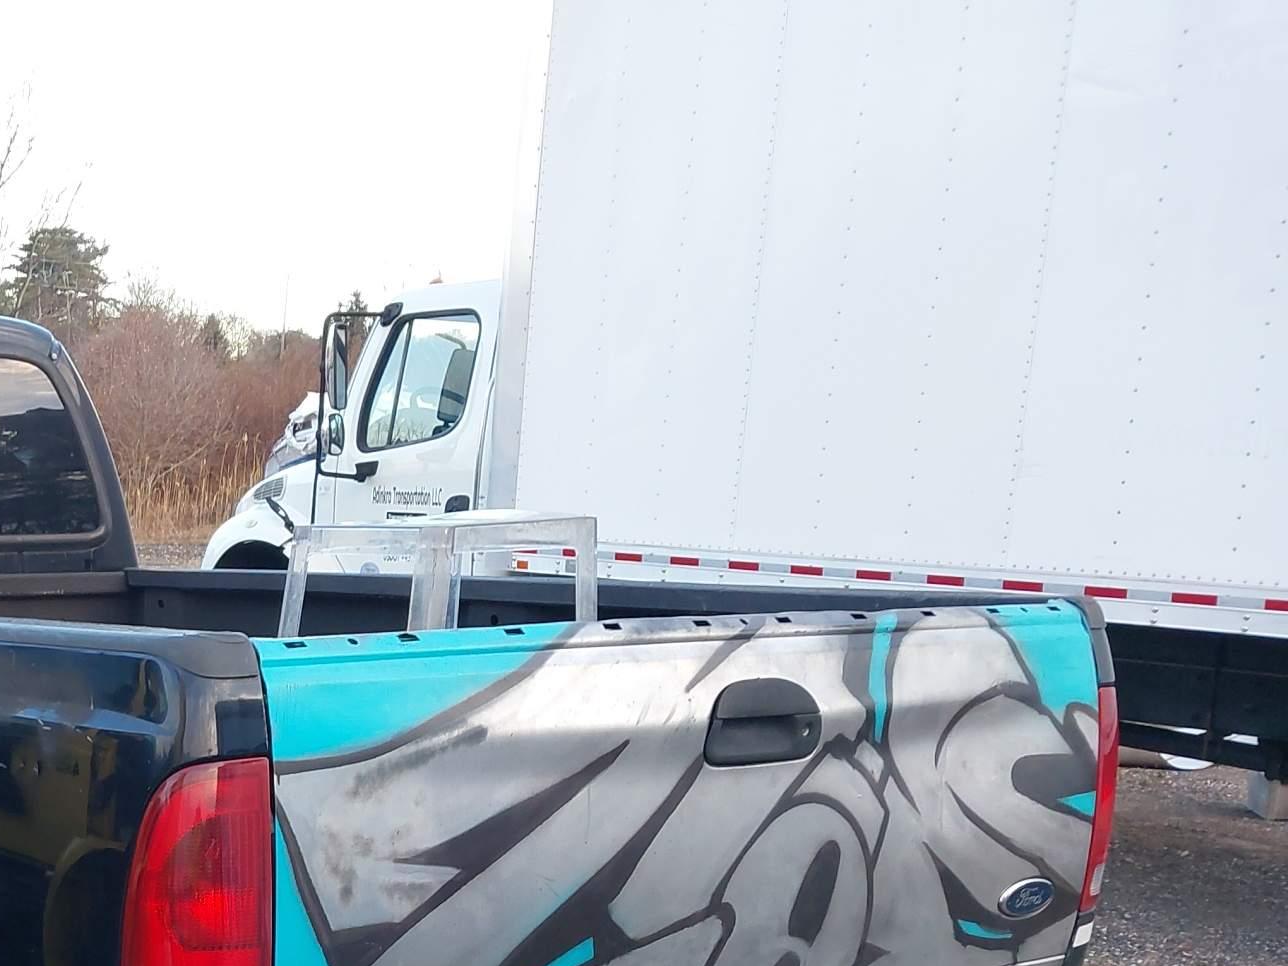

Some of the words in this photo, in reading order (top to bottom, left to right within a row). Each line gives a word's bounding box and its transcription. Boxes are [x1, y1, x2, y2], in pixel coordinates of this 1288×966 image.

[393, 486, 430, 510] Transportation
[432, 488, 443, 506] LLC
[1015, 887, 1043, 908] Ford
